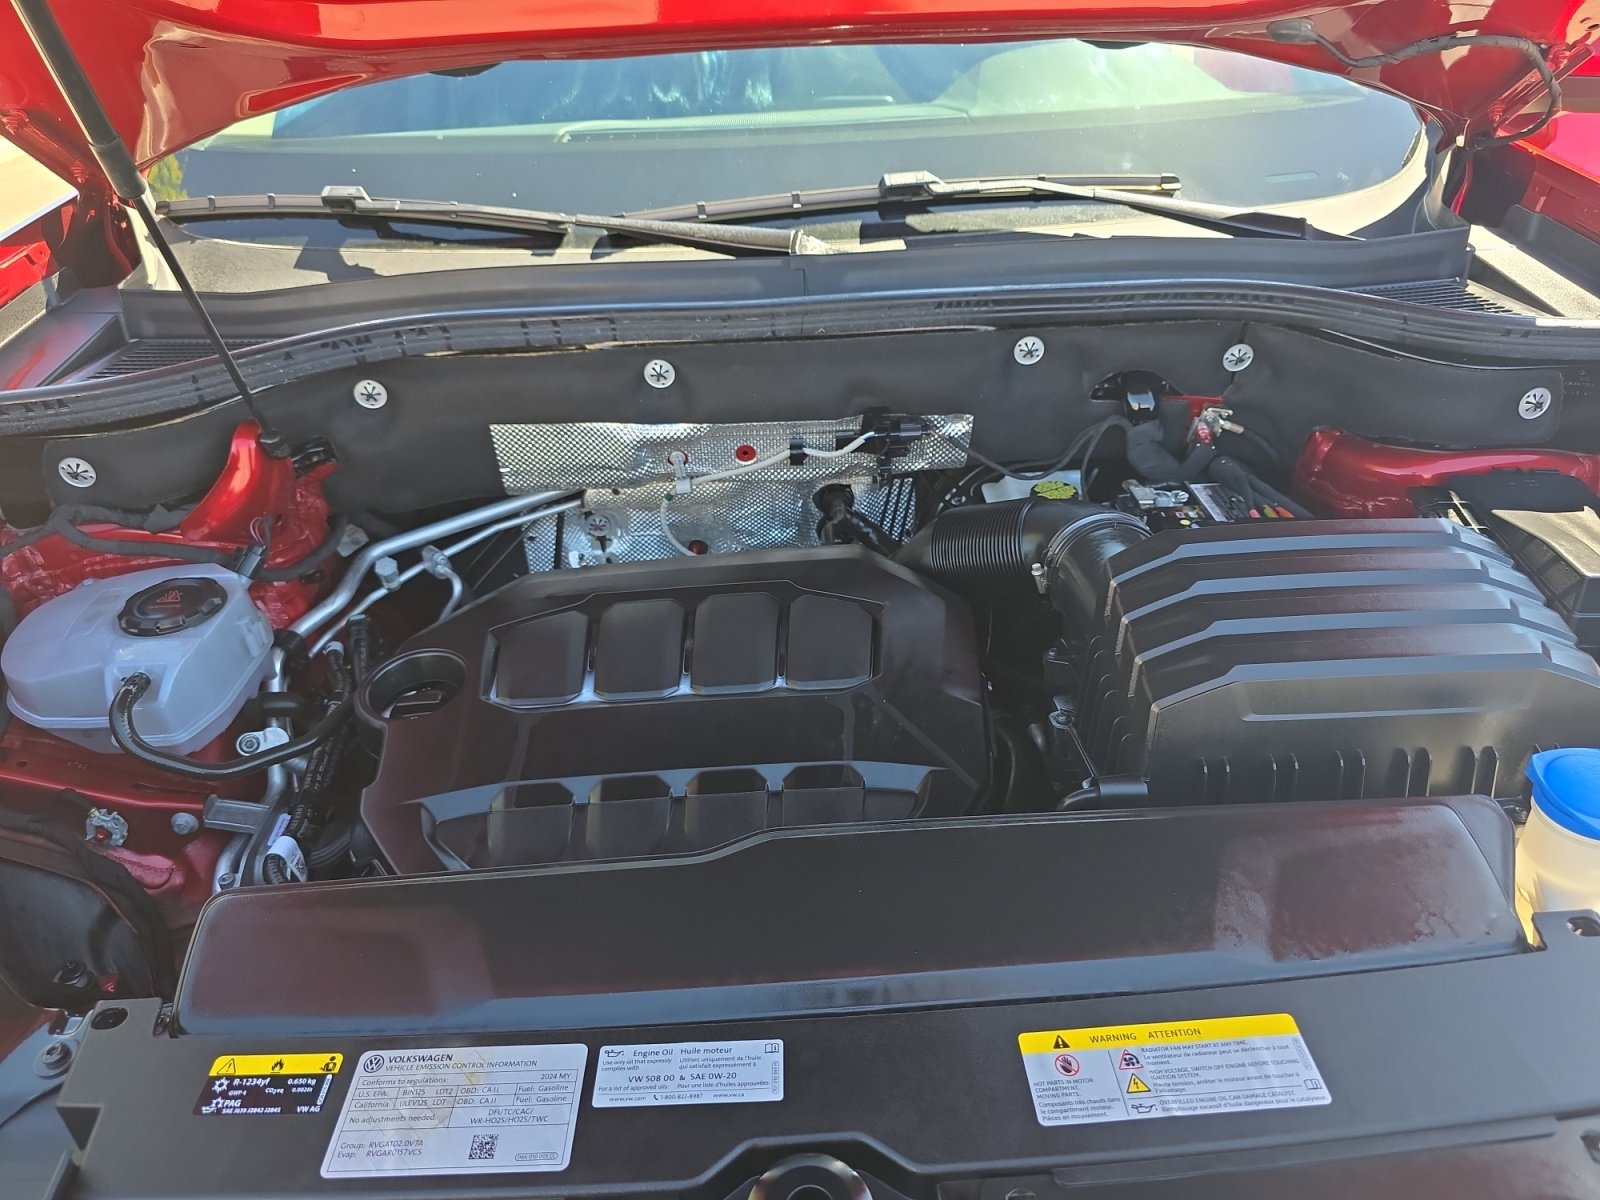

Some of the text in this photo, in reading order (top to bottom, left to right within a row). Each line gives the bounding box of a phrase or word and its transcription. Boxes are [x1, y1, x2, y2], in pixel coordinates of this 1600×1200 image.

[1089, 1028, 1201, 1043] WARNING ATTENTION
[389, 1054, 453, 1063] VOLKSWAGEN
[233, 1078, 271, 1086] R-1234yf
[361, 1116, 406, 1125] adjustments
[341, 1142, 366, 1150] Group:
